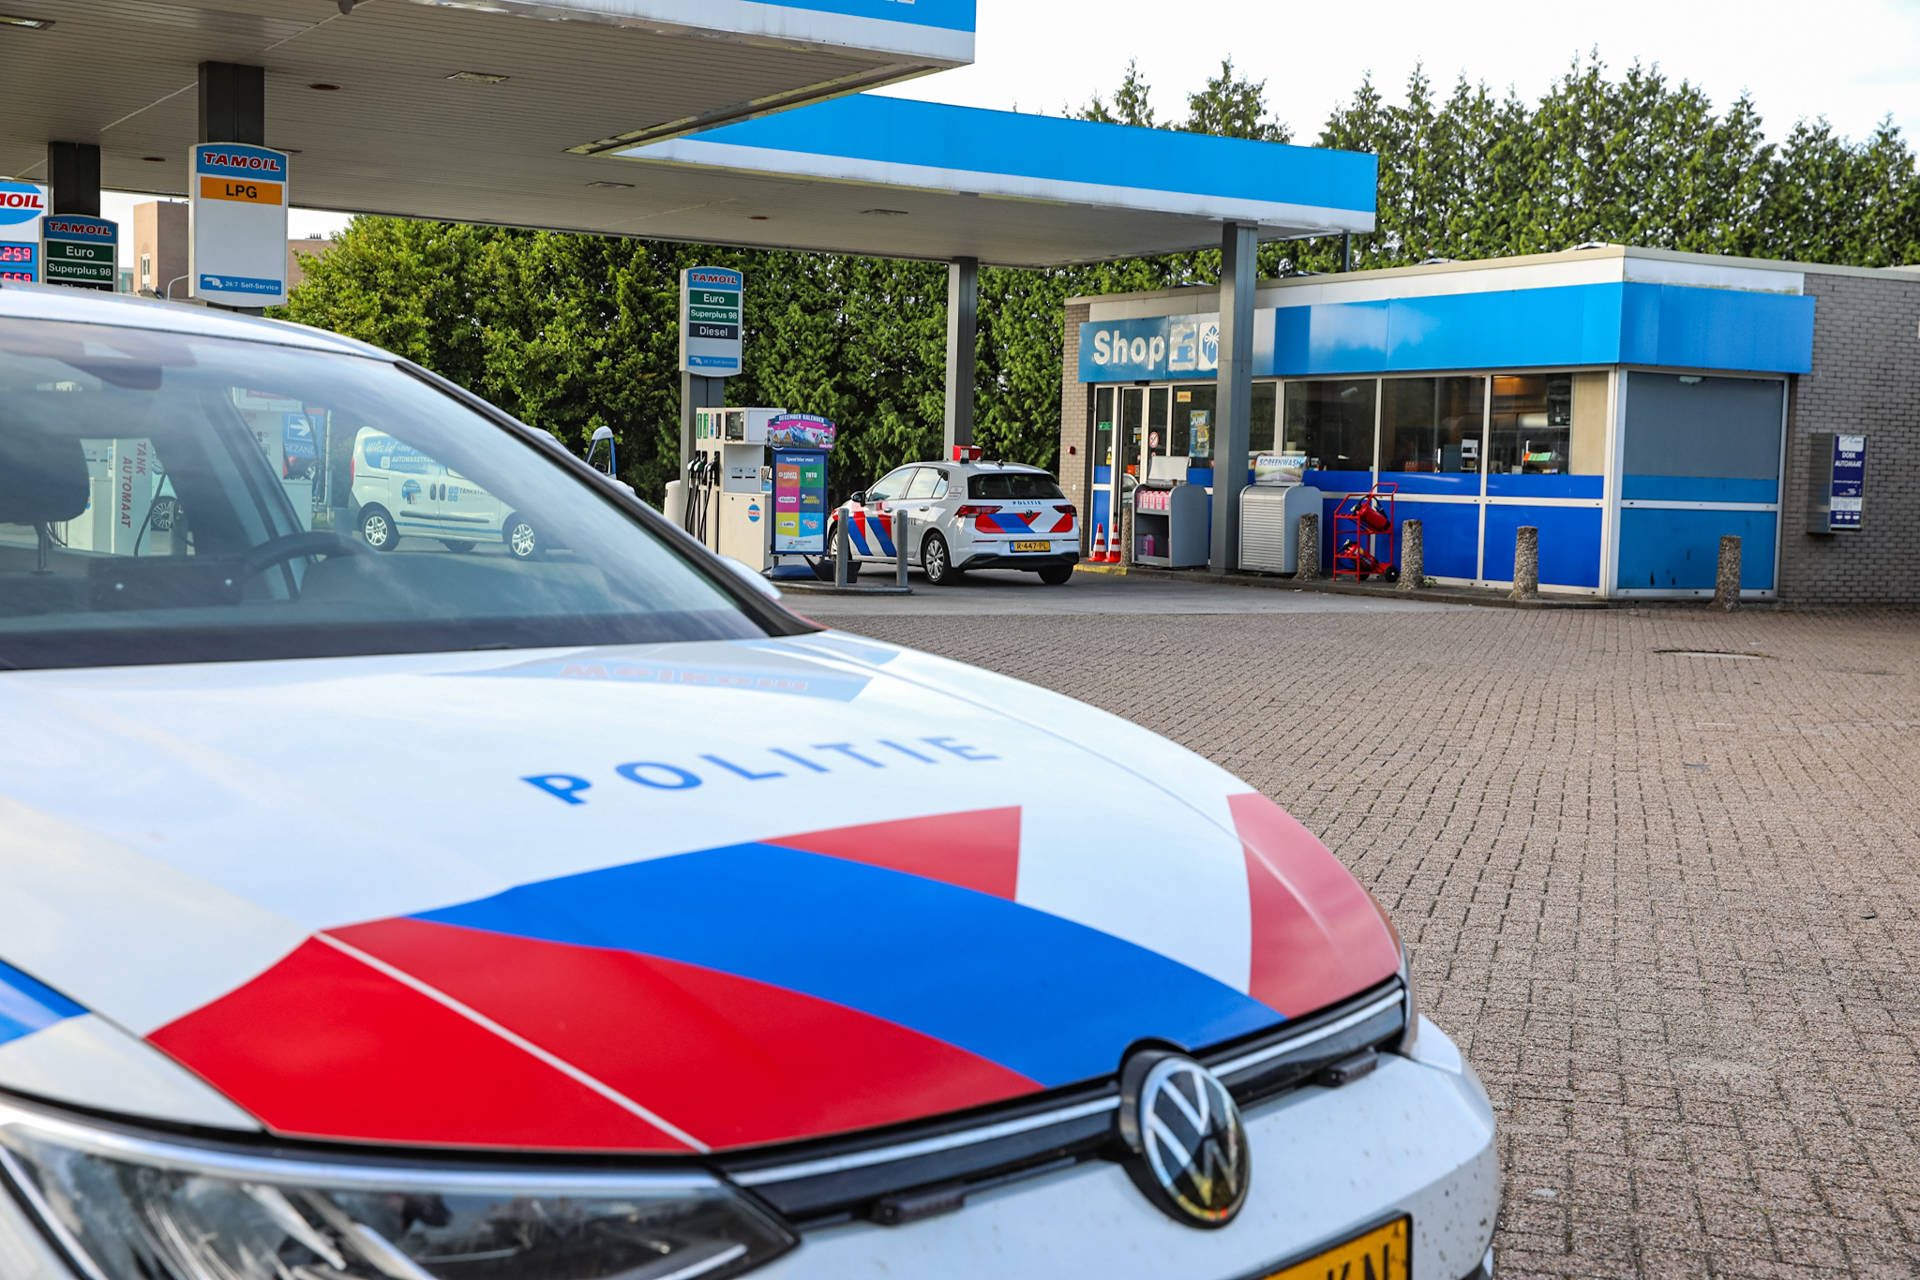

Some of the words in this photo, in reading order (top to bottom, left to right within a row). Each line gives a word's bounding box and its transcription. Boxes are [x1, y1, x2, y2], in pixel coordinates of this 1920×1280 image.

[204, 152, 281, 171] TAMOIL
[225, 183, 258, 199] LPG
[49, 222, 112, 236] TAMOIL
[66, 245, 95, 257] Euro
[48, 263, 98, 275] Superplus
[99, 267, 112, 276] 98
[692, 273, 737, 284] TAMOIL
[703, 293, 725, 304] Euro
[690, 309, 727, 319] Superplus
[728, 311, 738, 319] 98
[699, 326, 728, 336] Diesel
[1093, 329, 1165, 371] Shop
[136, 441, 146, 476] TANK
[121, 455, 133, 528] AUTOMAAT
[520, 737, 1001, 805] POLITIE
